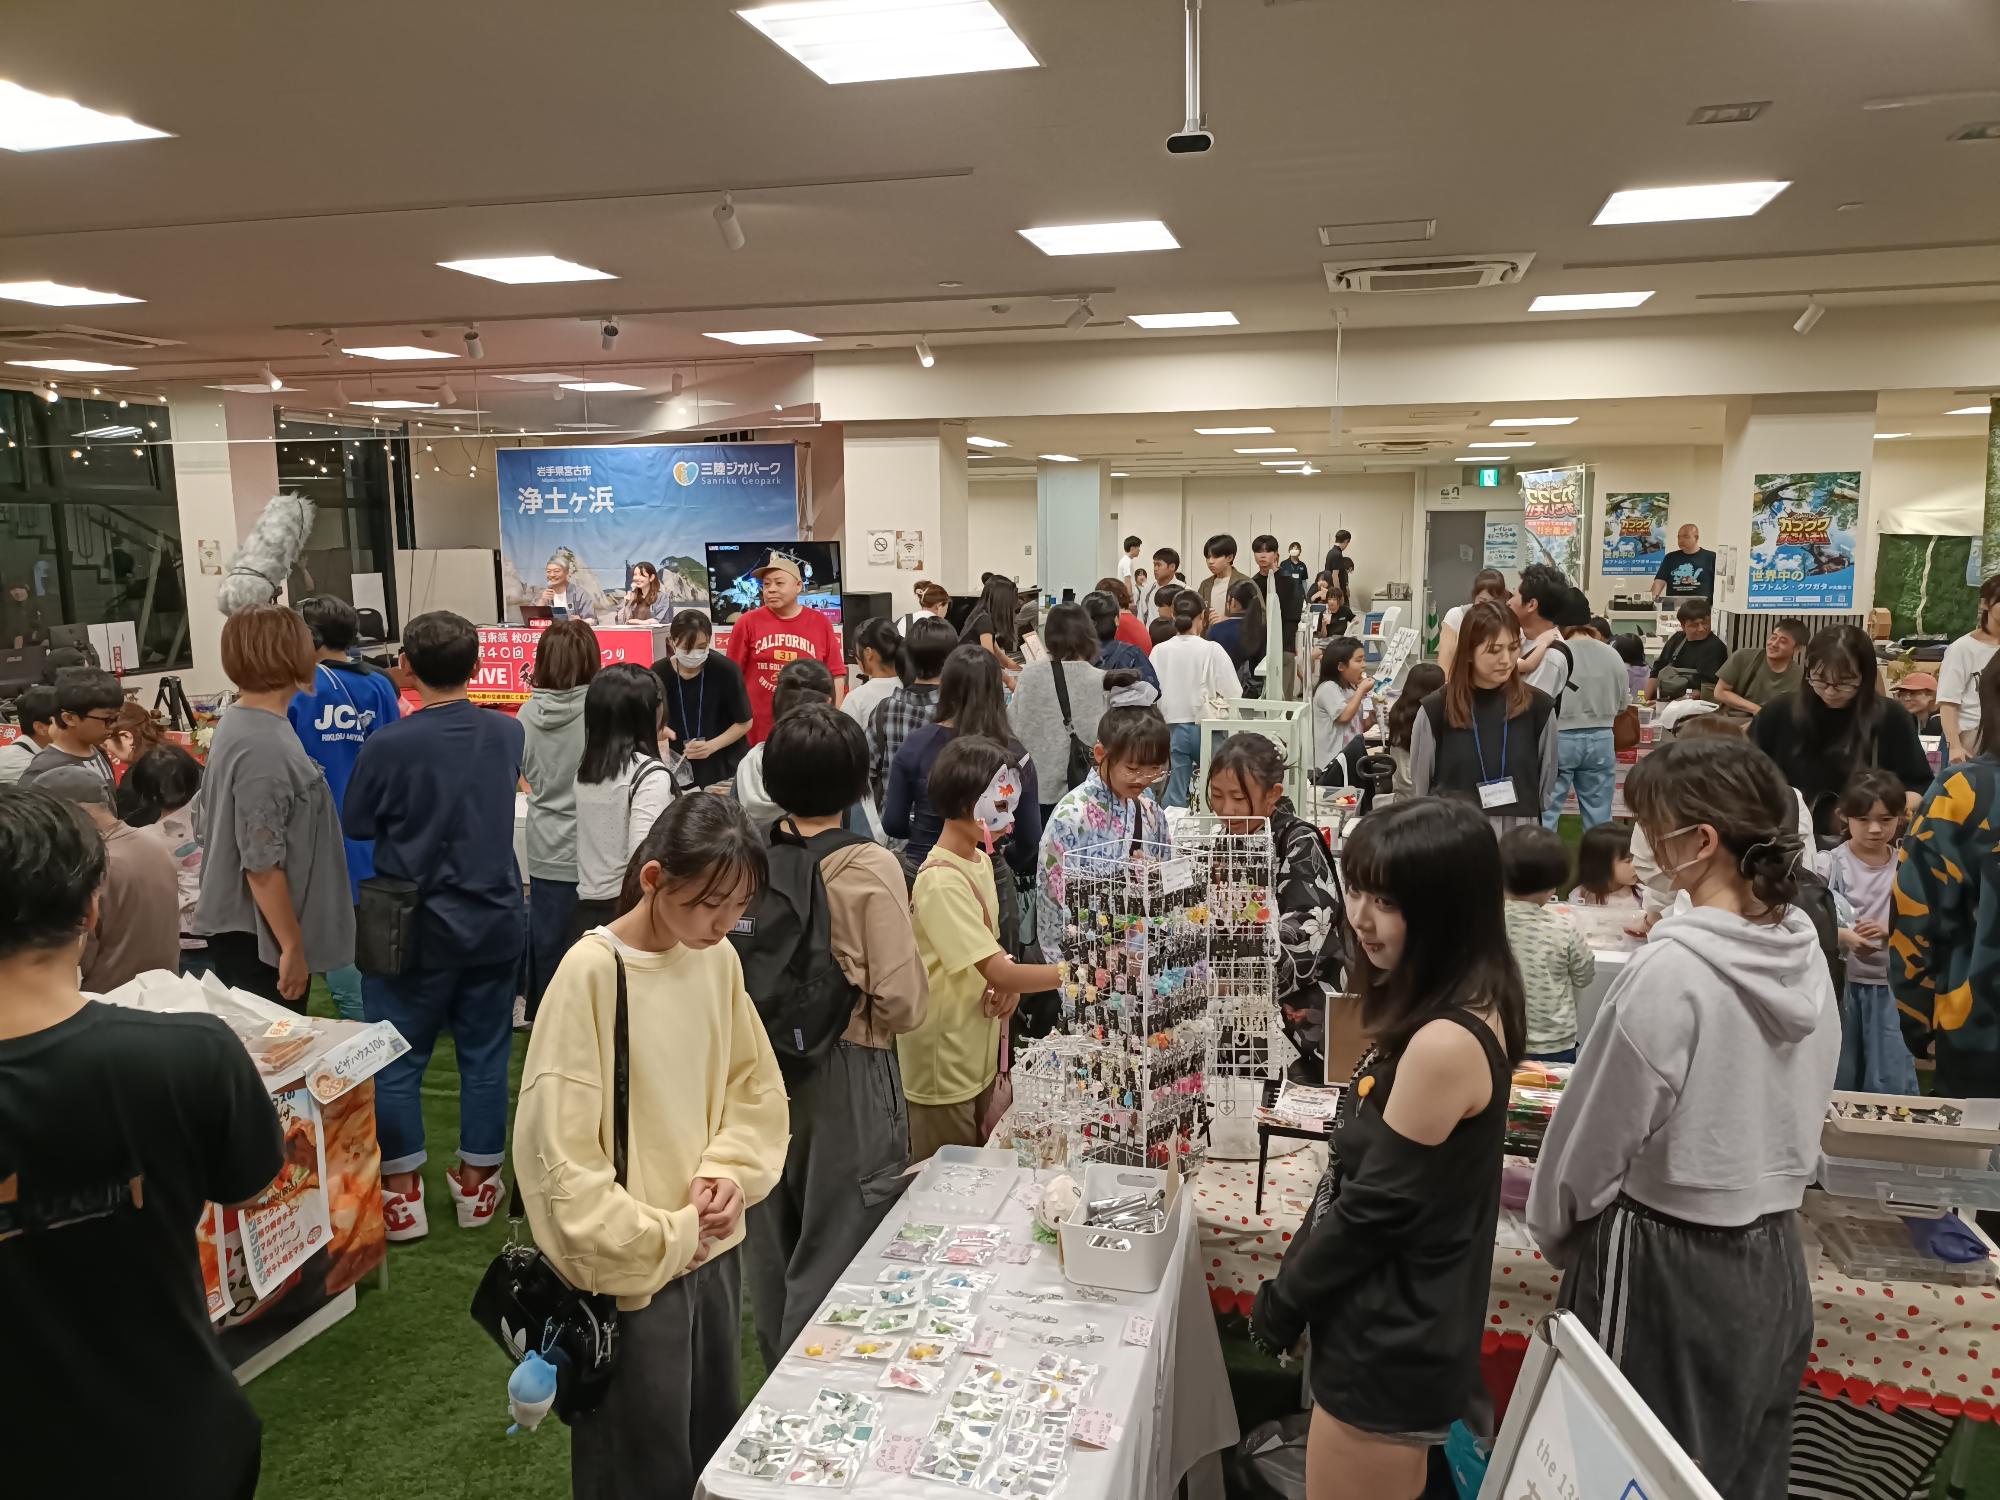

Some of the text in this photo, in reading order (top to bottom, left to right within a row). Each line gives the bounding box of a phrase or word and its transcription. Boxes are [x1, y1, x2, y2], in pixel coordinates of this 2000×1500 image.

[536, 465, 592, 477] 岩手県宮古市
[701, 462, 781, 475] 三陸ジオパーク
[701, 476, 781, 486] Sanriku Geopark
[1751, 569, 1804, 582] 世界中の
[755, 634, 816, 658] CALIFORNIA
[769, 663, 785, 671] GOL
[1536, 1438, 1580, 1500] the 13
